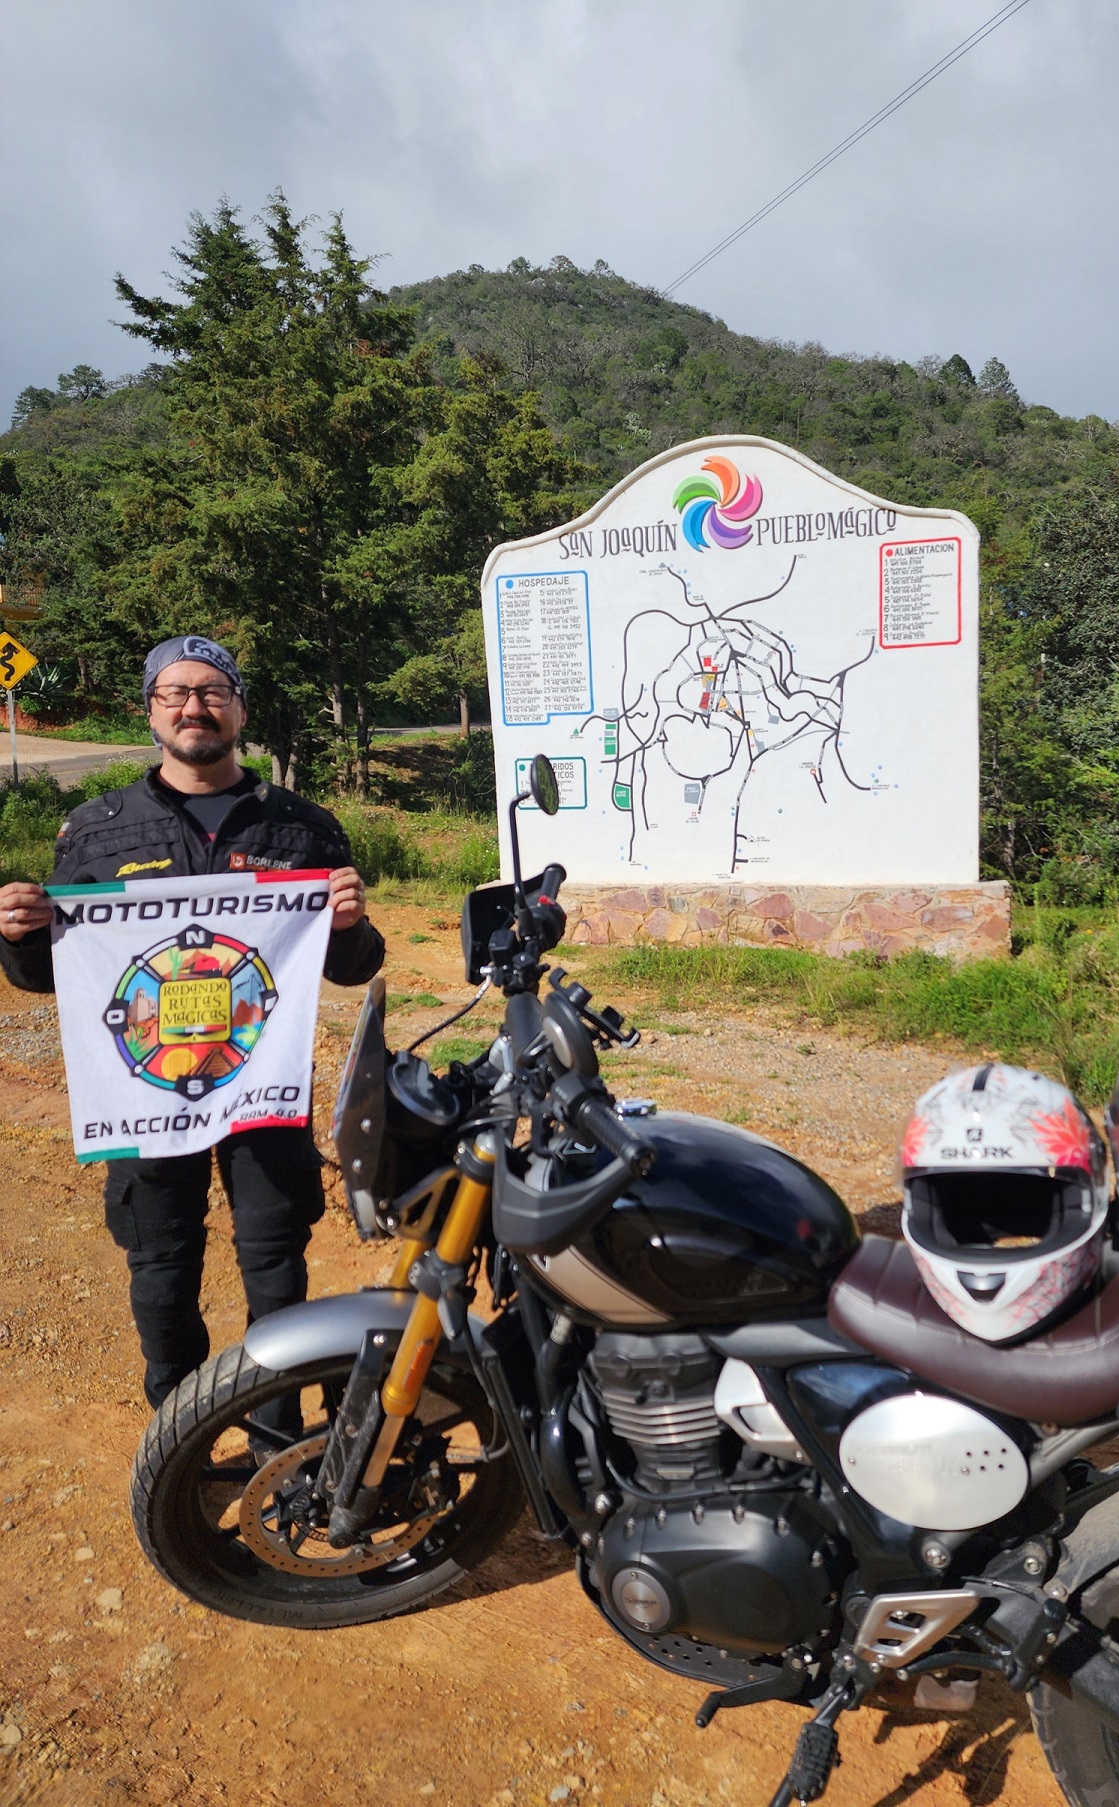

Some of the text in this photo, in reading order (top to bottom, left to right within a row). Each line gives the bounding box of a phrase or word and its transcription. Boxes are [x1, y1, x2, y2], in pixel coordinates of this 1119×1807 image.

[894, 543, 955, 557] ALIMENTACION
[883, 568, 889, 577] 2
[518, 576, 570, 588] HOSPEDAJE
[884, 578, 890, 586] 3
[884, 596, 890, 604] 5
[883, 605, 890, 613] 6
[883, 614, 889, 622] 7
[883, 624, 889, 632] 8
[883, 633, 889, 641] 9
[53, 891, 329, 925] MOTOTURISMO
[186, 930, 206, 945] N
[106, 1009, 125, 1024] O
[187, 1080, 205, 1095] S
[83, 1119, 113, 1140] EN
[120, 1106, 212, 1137] ACCIÓN
